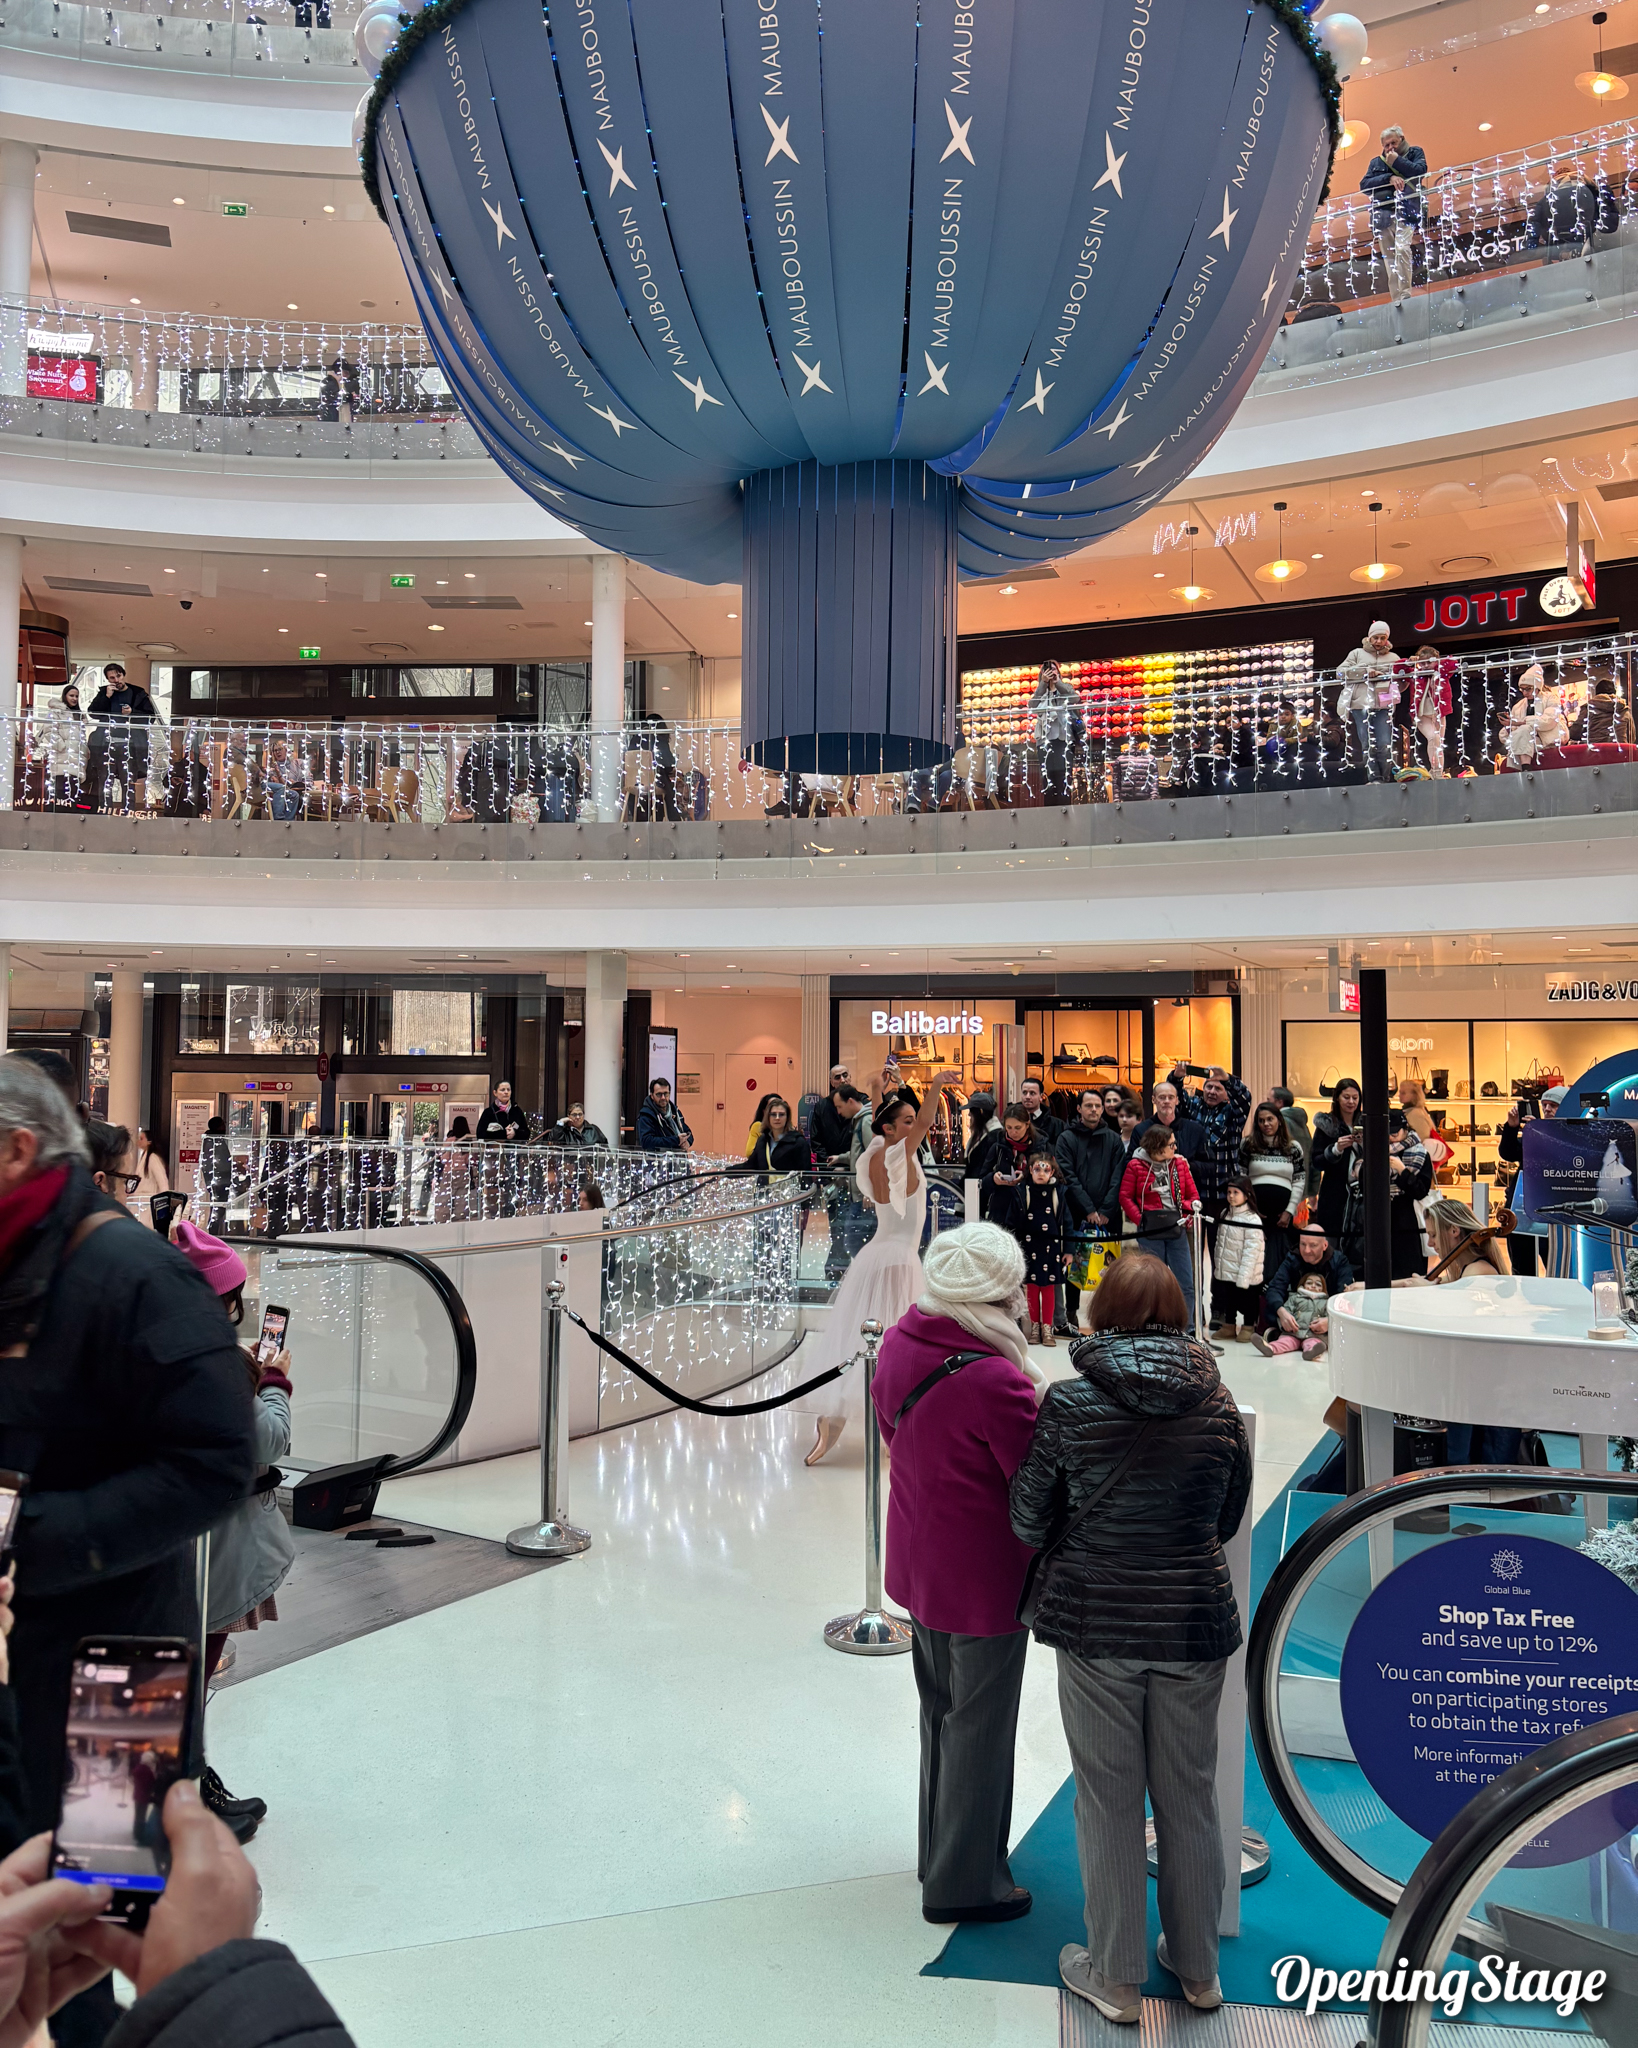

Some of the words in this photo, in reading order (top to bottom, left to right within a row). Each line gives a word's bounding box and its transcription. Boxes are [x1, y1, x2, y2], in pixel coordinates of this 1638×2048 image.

[441, 23, 492, 189] MAUBOUSSIN
[1232, 24, 1281, 189] MAUBOUSSIN
[382, 113, 432, 259] MAUBOUSSIN
[1280, 118, 1328, 262] MAUBOUSSIN
[618, 206, 688, 367] MAUBOUSSIN
[772, 179, 814, 348] MAUBOUSSIN
[930, 178, 964, 348] MAUBOUSSIN
[1044, 206, 1110, 368] MAUBOUSSIN
[452, 314, 541, 437] MAUBOUSSIN
[507, 254, 593, 399] MAUBOUSSIN
[1134, 253, 1218, 401] MAUBOUSSIN
[1168, 318, 1257, 443] MAUBOUSSIN
[1413, 587, 1527, 631] JOTT
[871, 1010, 983, 1034] Balibaris
[1552, 1388, 1611, 1399] DUTCHGRAND
[1421, 1629, 1455, 1647] and
[1459, 1633, 1502, 1649] save
[1506, 1636, 1529, 1655] up
[1534, 1635, 1554, 1651] to
[1558, 1636, 1598, 1653] 12%
[1439, 1604, 1489, 1630] Shop
[1492, 1607, 1526, 1627] Tax
[1531, 1609, 1575, 1629] Free
[1484, 1585, 1510, 1595] Global
[1512, 1586, 1531, 1595] Blue
[1377, 1662, 1408, 1681] You
[1413, 1669, 1442, 1683] can
[1446, 1668, 1521, 1686] combine
[1525, 1674, 1565, 1691] your
[1408, 1713, 1427, 1728] to
[1431, 1714, 1486, 1732] obtain
[1490, 1716, 1518, 1733] the
[1522, 1718, 1551, 1735] tax
[1554, 1719, 1584, 1735] ref
[1411, 1691, 1433, 1705] on
[1437, 1692, 1549, 1715] participating
[1551, 1697, 1608, 1714] stores
[1414, 1746, 1453, 1762] More
[1435, 1769, 1450, 1782] at
[1453, 1770, 1477, 1783] the
